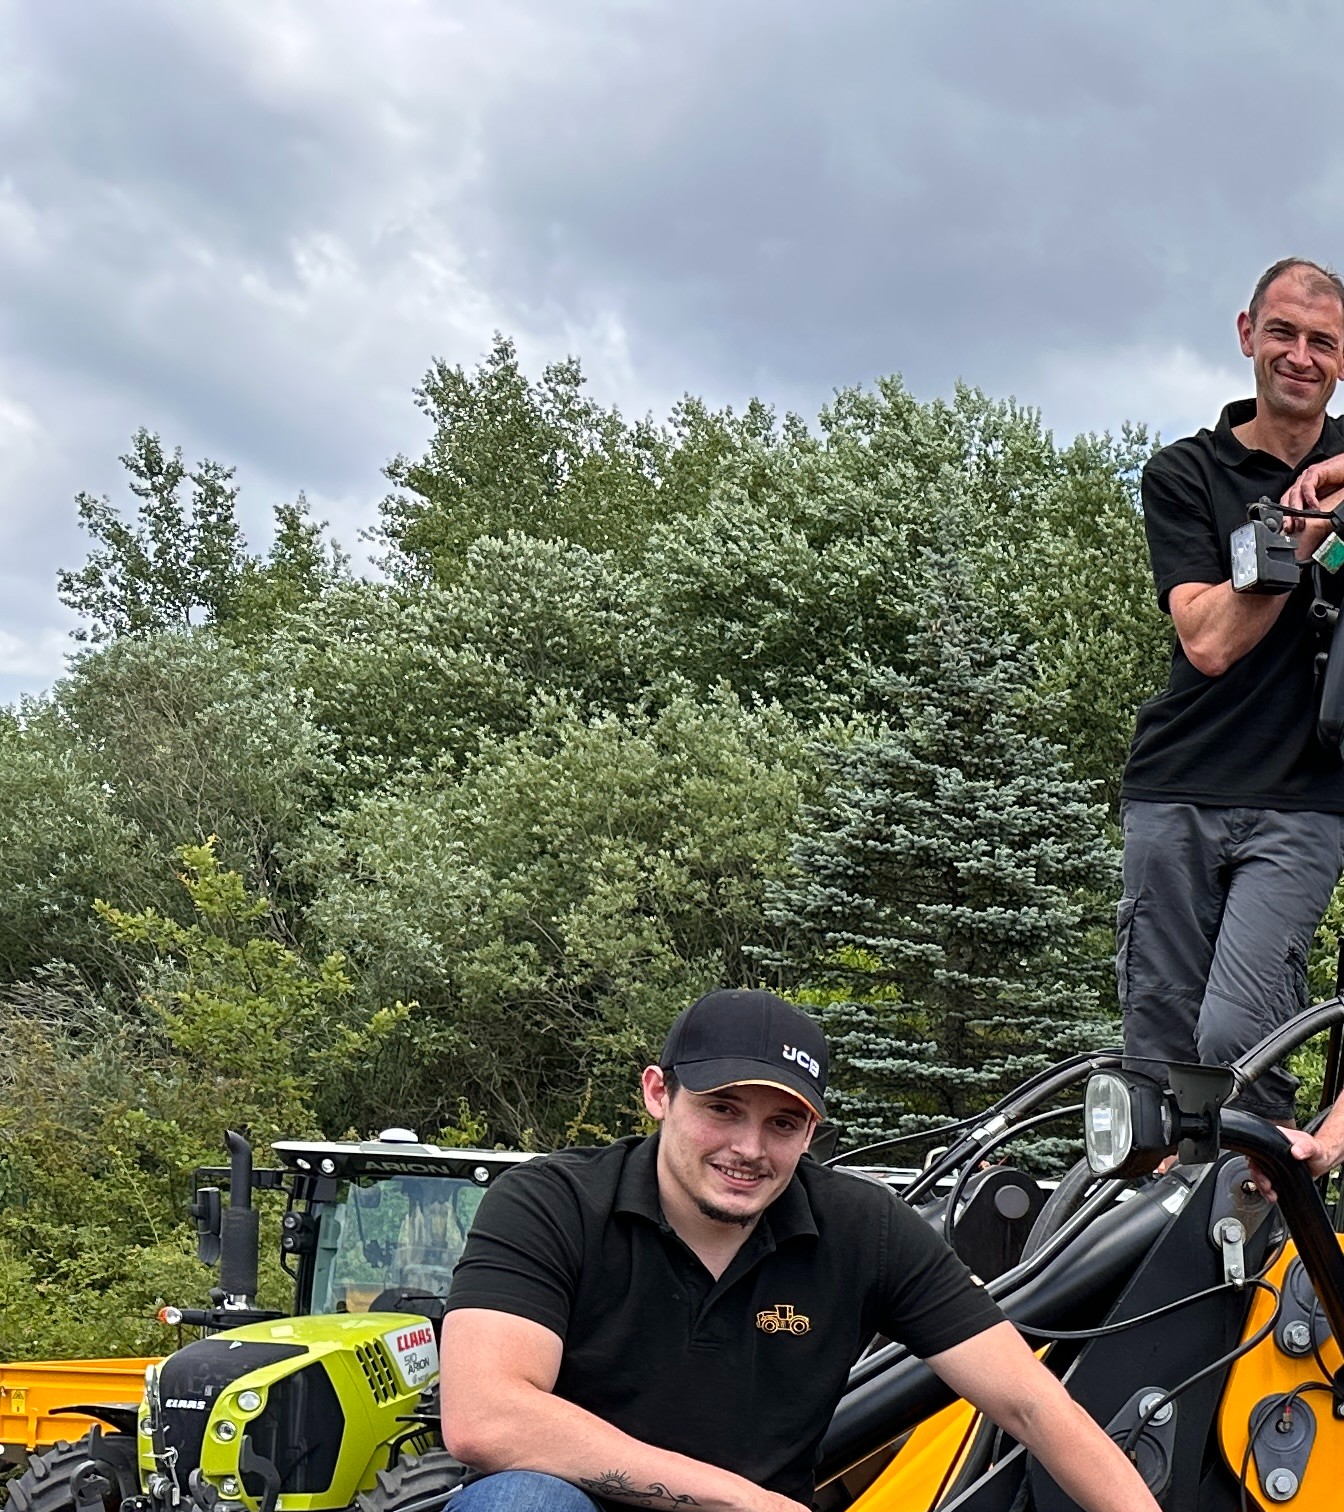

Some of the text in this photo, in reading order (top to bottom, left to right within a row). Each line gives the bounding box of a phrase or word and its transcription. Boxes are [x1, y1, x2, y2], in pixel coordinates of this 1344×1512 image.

[782, 1044, 820, 1079] JCB
[365, 1161, 451, 1174] ARION
[397, 1327, 432, 1353] CLAAS
[408, 1356, 430, 1375] ARION
[165, 1399, 207, 1410] CLAAS
